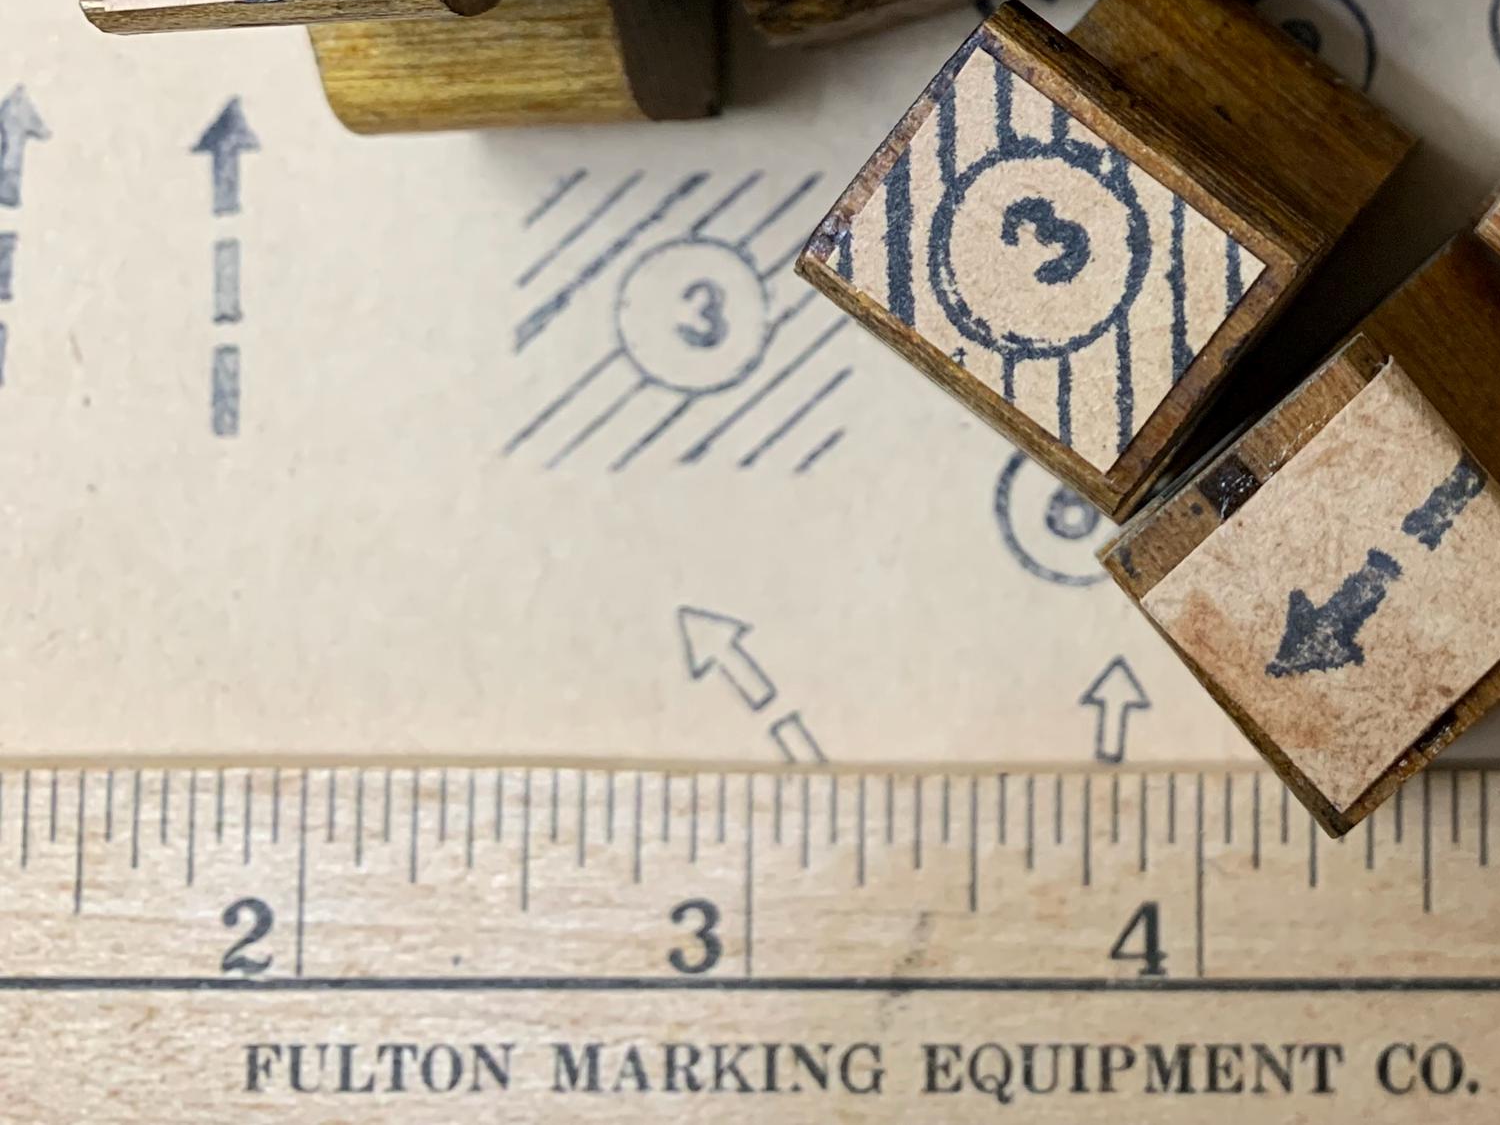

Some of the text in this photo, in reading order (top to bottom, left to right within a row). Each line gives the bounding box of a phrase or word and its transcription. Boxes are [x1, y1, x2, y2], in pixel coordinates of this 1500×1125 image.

[999, 196, 1092, 286] 3
[676, 279, 729, 350] 3
[220, 897, 275, 976] 2
[667, 899, 723, 975] 3
[1109, 902, 1168, 976] 4
[245, 1043, 515, 1093] FULTON
[552, 1042, 886, 1095] MARKING
[923, 1043, 1344, 1105] EQUIPMENT
[1376, 1043, 1480, 1095] CO.
